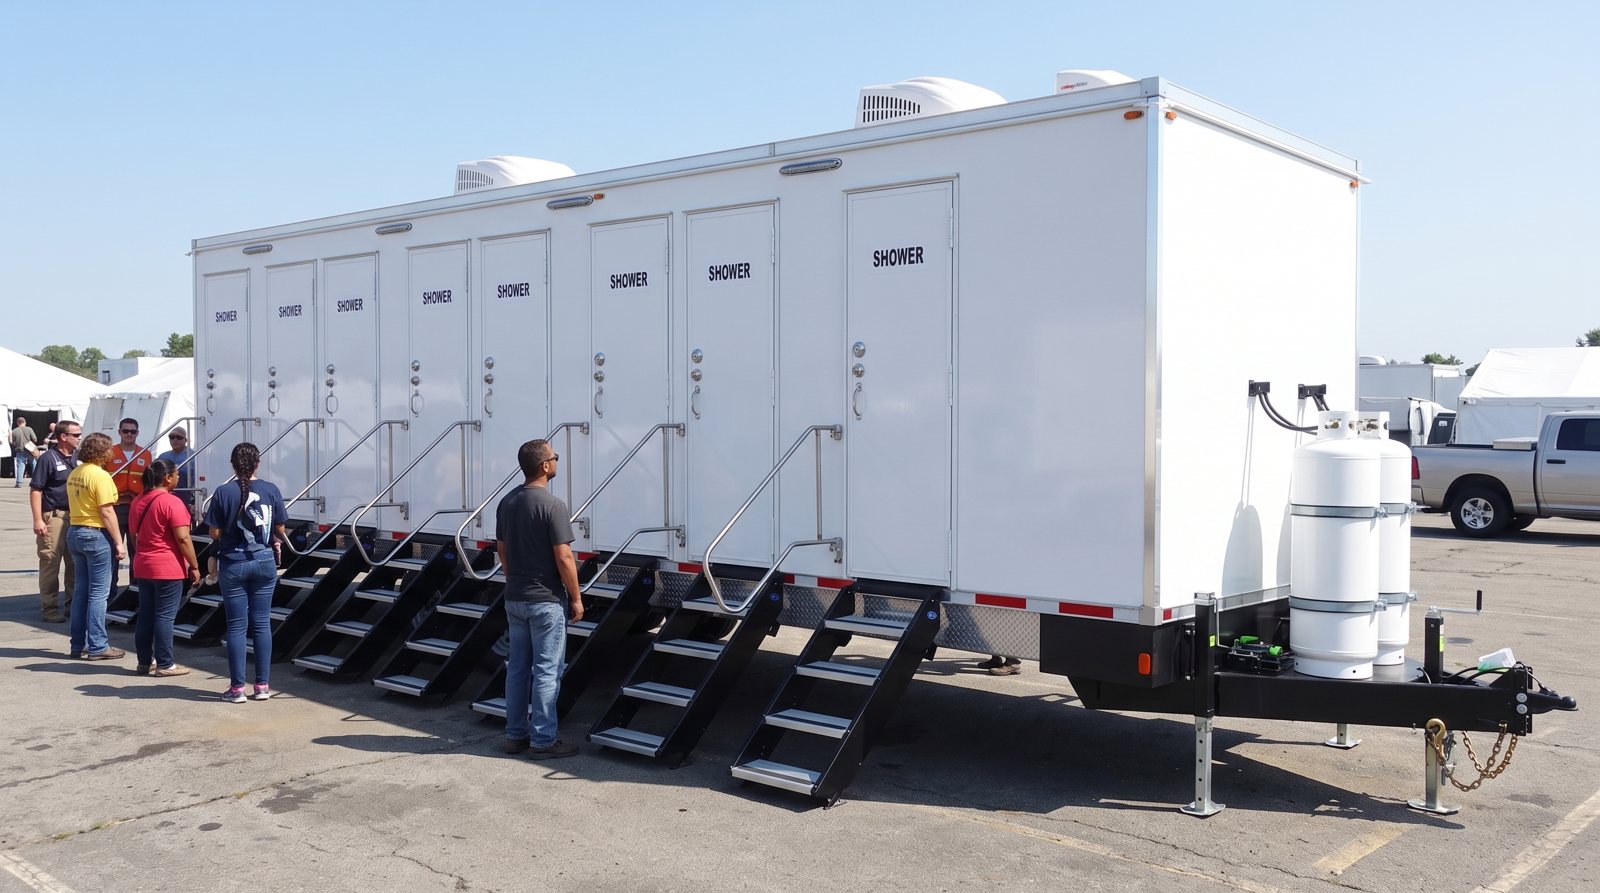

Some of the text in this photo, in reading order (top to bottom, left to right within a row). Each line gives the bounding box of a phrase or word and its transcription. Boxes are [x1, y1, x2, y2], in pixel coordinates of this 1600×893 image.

[872, 246, 923, 268] SHOWER
[709, 263, 750, 281] SHOWER
[610, 272, 647, 289] SHOWER
[422, 290, 452, 306] SHOWER
[498, 283, 530, 299] SHOWER
[279, 304, 302, 318] SHOWER
[337, 299, 363, 313] SHOWER
[215, 310, 237, 323] SHOWER
